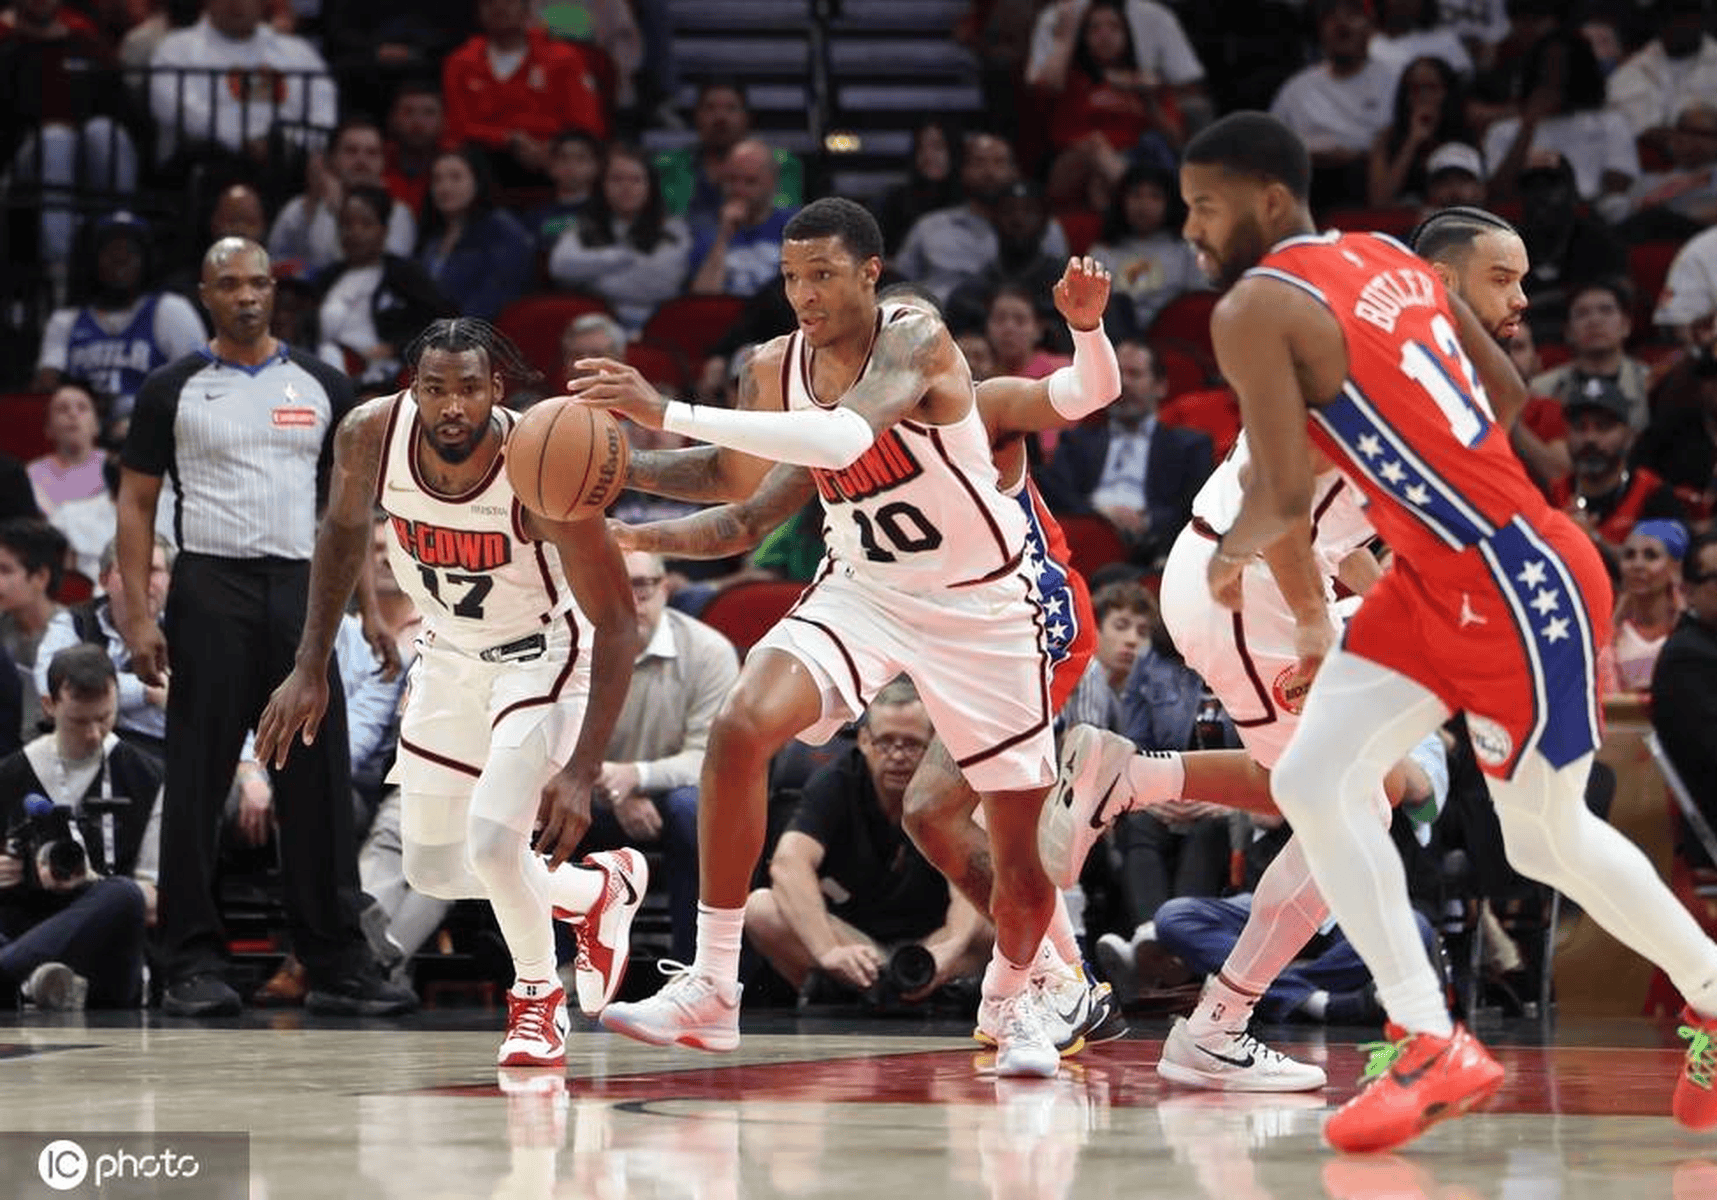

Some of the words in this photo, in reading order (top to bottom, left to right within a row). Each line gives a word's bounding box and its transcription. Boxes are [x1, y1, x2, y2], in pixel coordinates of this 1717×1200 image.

[1354, 267, 1436, 335] BUTLER
[1399, 311, 1496, 448] 12
[582, 426, 620, 506] Wilson
[851, 501, 943, 563] 10
[416, 563, 494, 620] 17
